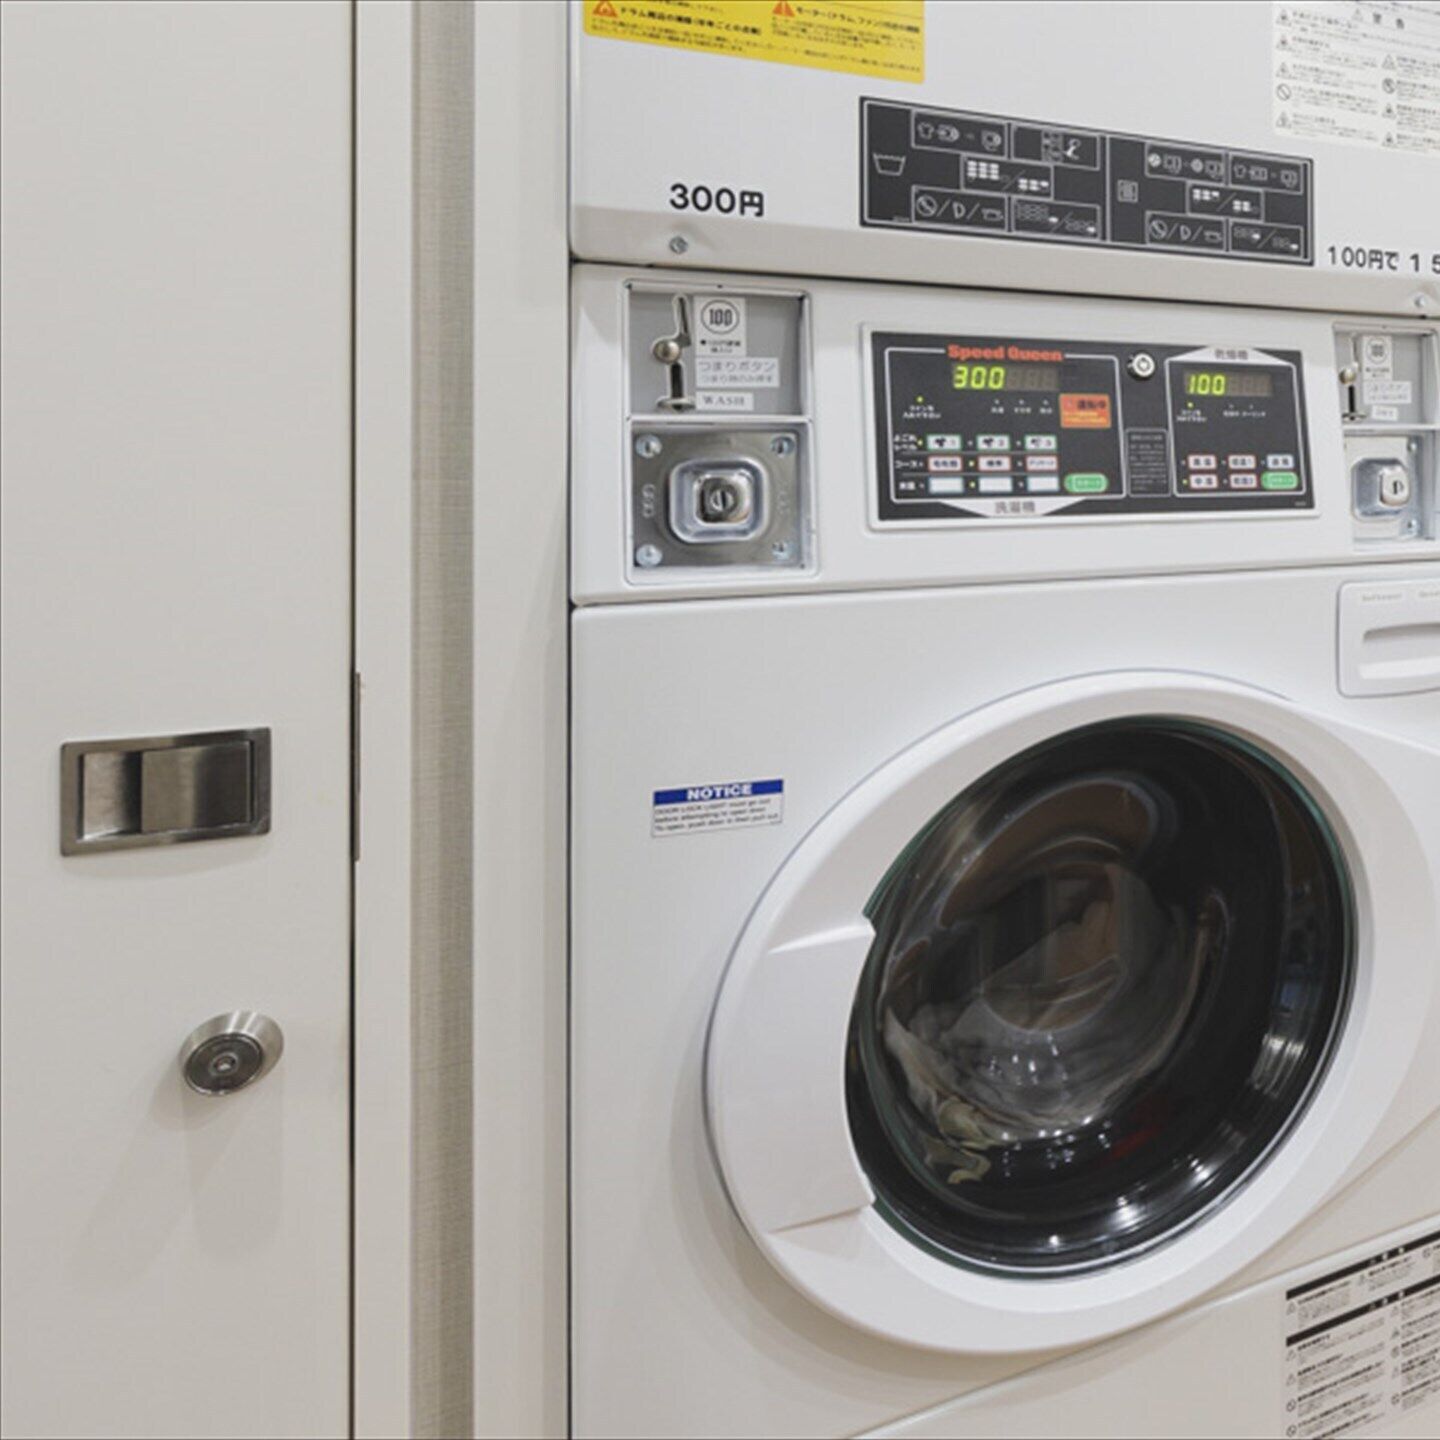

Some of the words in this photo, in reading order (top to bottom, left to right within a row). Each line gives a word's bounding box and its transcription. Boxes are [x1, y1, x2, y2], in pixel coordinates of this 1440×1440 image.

[669, 183, 764, 217] 300円
[1328, 246, 1399, 271] 100円で
[709, 308, 733, 326] 100
[947, 344, 1005, 361] Speed
[1007, 346, 1064, 362] Queen
[699, 360, 776, 372] つまりボタン
[953, 366, 1005, 389] 300
[1188, 374, 1226, 395] 100
[995, 500, 1036, 514] 洗濯機
[687, 783, 752, 801] NOTICE
